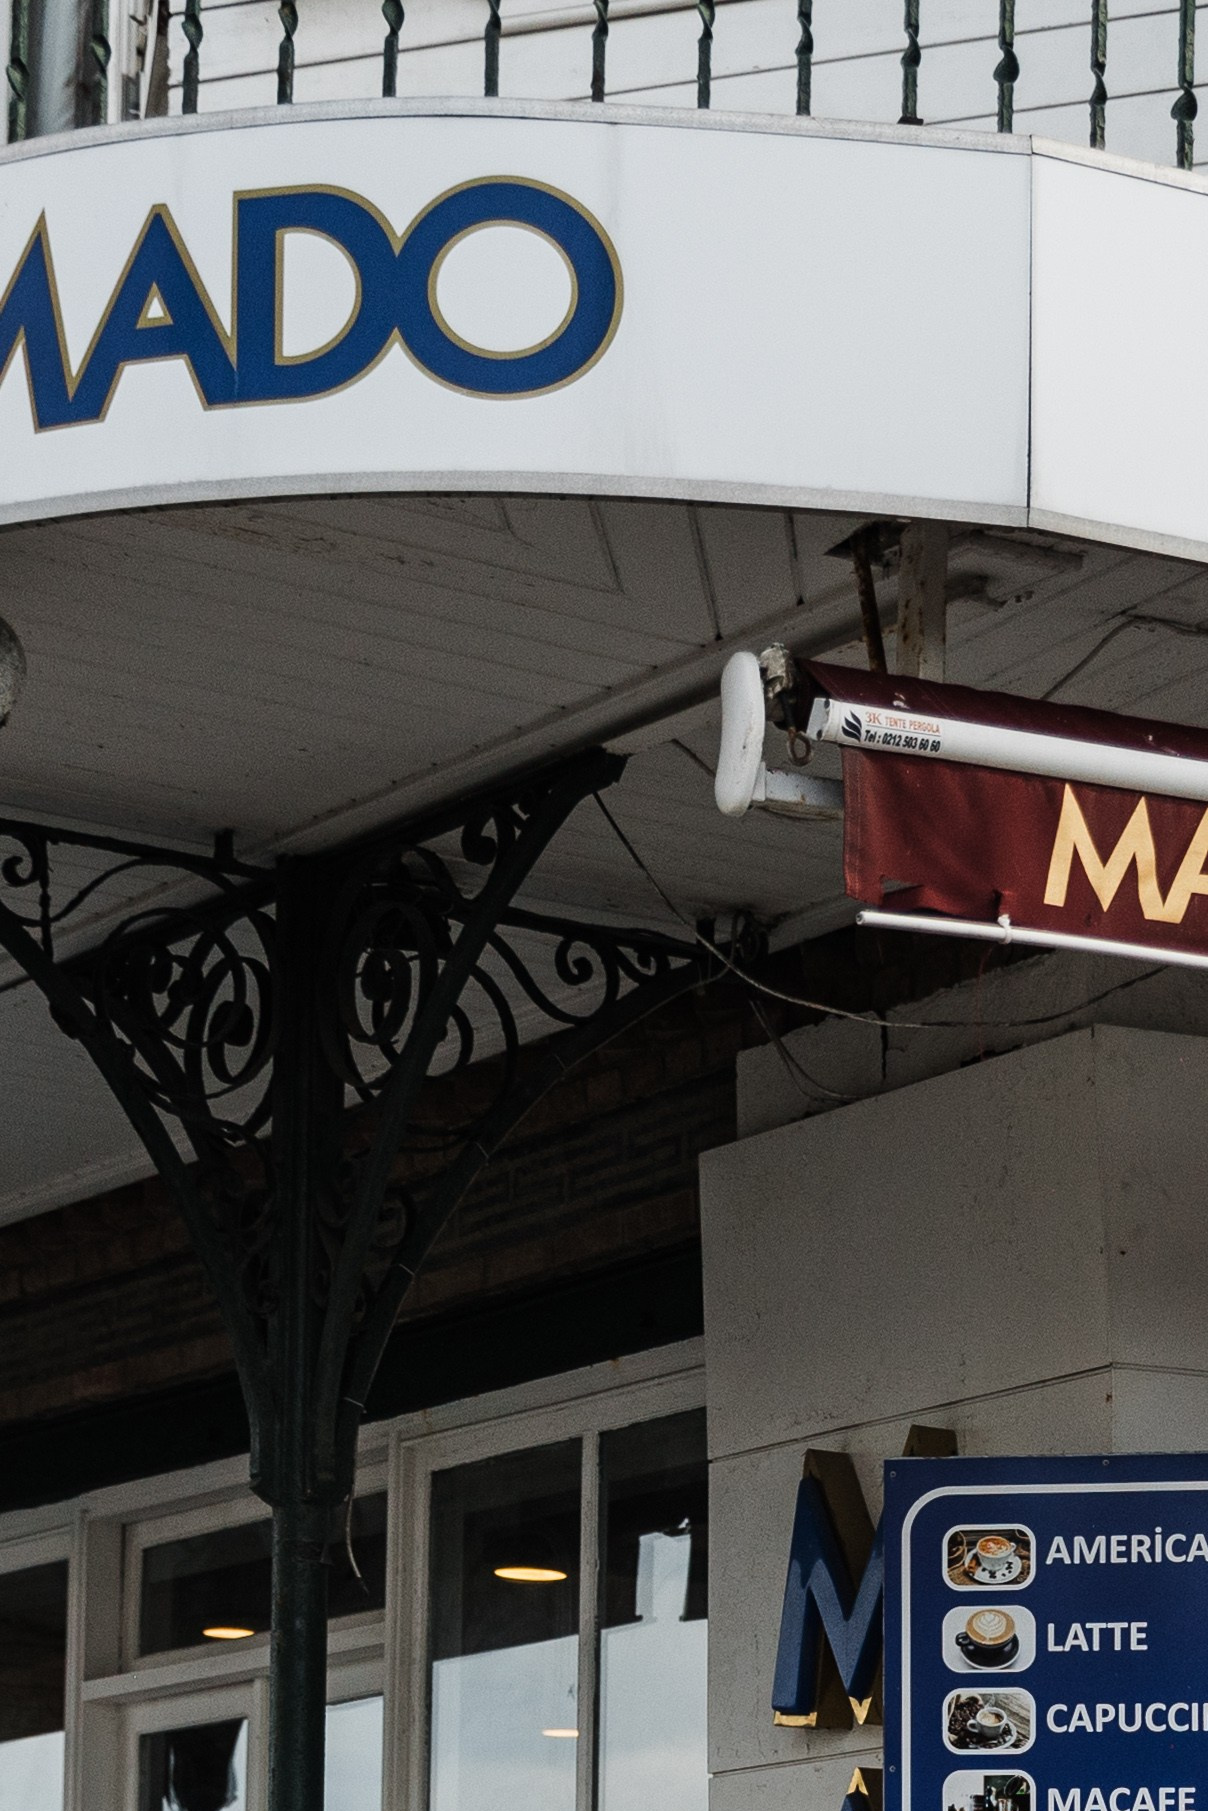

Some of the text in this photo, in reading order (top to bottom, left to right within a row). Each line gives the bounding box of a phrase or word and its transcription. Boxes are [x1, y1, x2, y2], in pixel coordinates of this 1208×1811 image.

[865, 711, 940, 734] 3K TENTE PERGOLA
[863, 730, 877, 742] Tel
[882, 732, 902, 747] 0212
[902, 736, 917, 749] 503
[918, 738, 929, 751] 60
[930, 740, 941, 753] 60
[1047, 1622, 1148, 1652] LATTE
